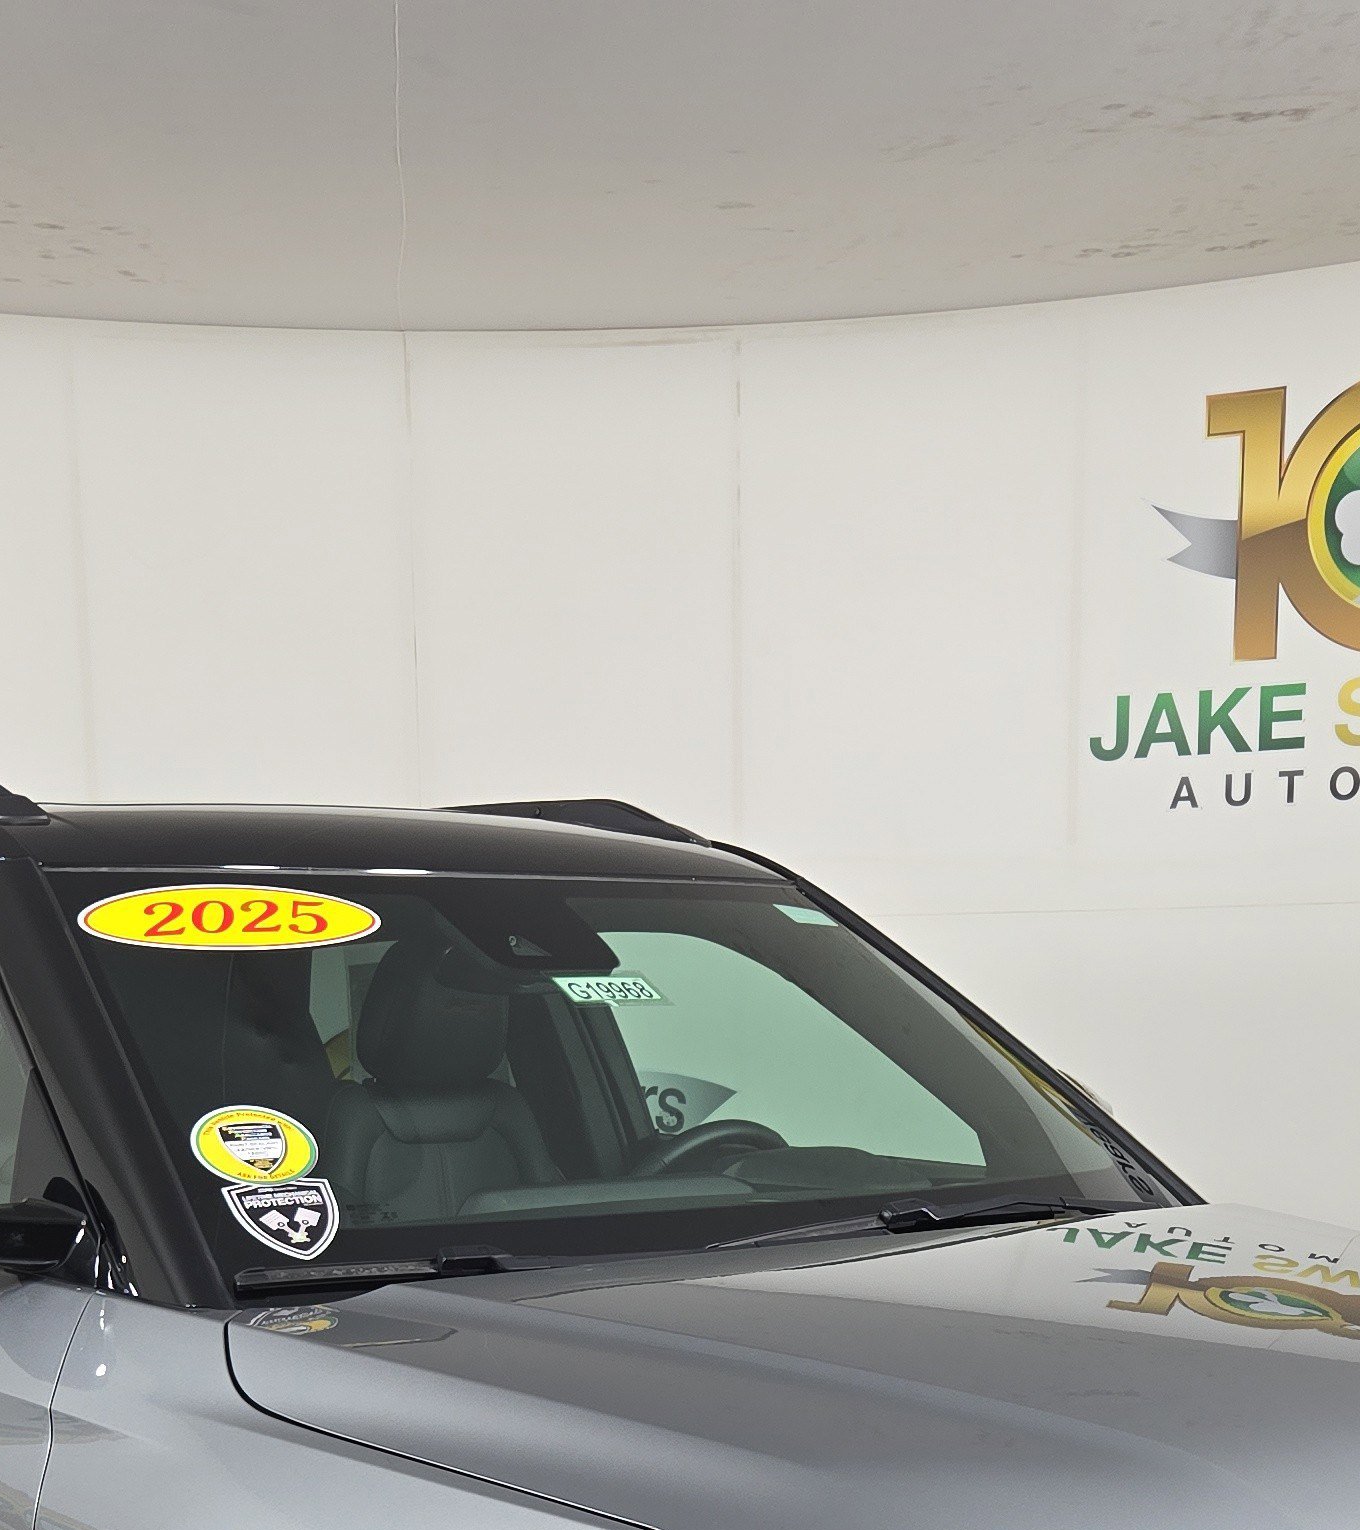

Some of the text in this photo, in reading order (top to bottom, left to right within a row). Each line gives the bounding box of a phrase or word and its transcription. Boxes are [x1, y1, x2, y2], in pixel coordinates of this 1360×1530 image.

[1089, 682, 1307, 762] JAKE
[143, 899, 329, 937] 2025
[567, 980, 654, 1000] G19968
[244, 1194, 324, 1210] PROTECTION
